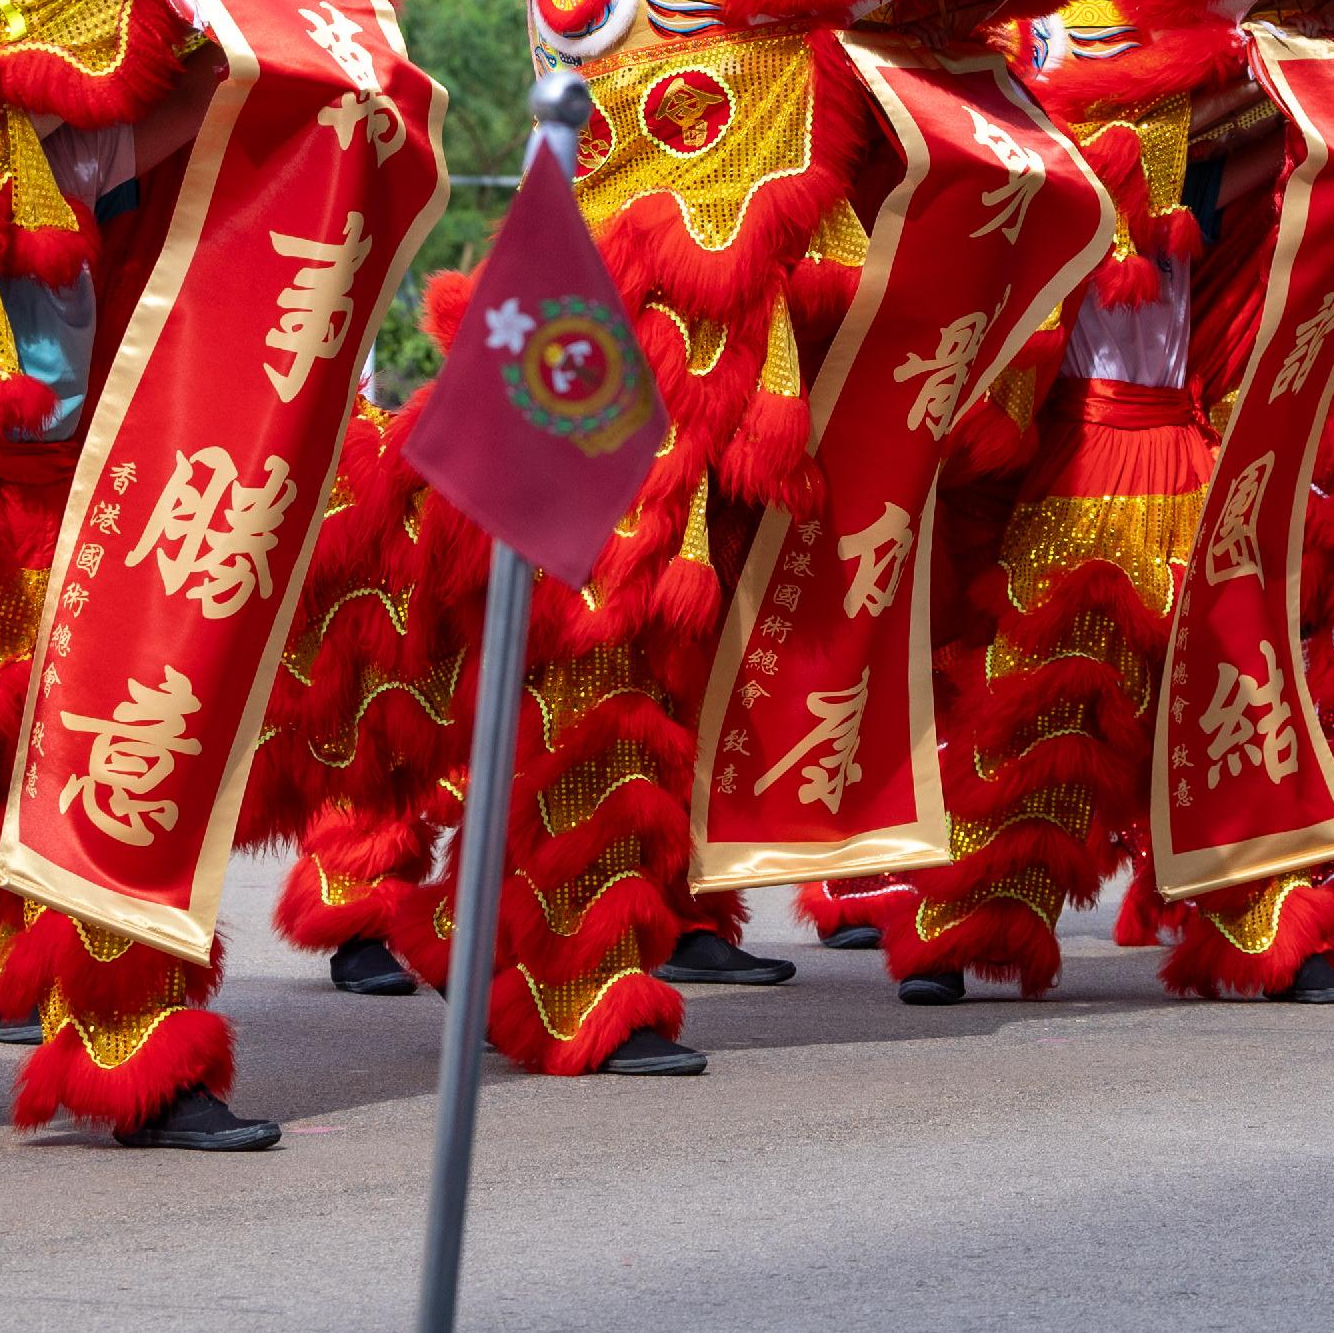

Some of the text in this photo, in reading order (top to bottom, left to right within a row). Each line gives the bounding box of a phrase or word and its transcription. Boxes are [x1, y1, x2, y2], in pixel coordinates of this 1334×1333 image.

[59, 1, 407, 847] 萬事勝意
[25, 461, 137, 799] 香港國術總會 致意
[716, 520, 823, 796] 香港國術總會 致意
[1171, 746, 1194, 808] 致意
